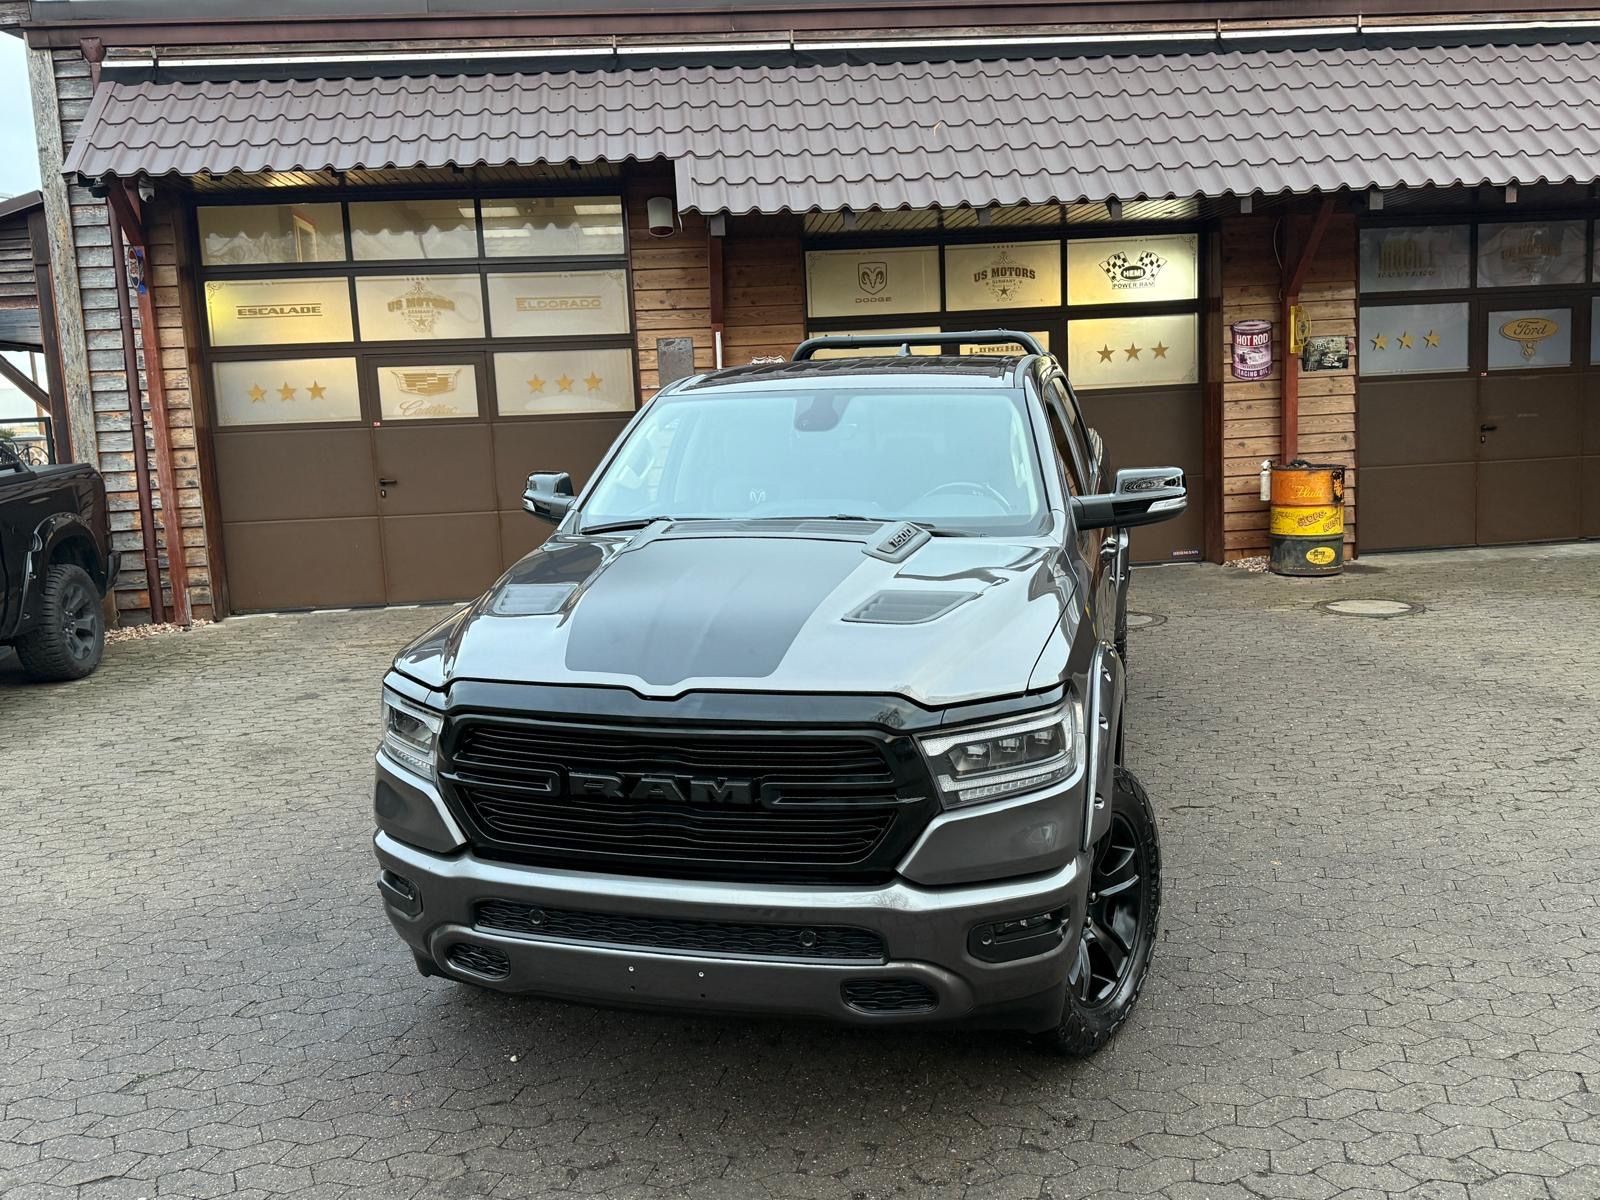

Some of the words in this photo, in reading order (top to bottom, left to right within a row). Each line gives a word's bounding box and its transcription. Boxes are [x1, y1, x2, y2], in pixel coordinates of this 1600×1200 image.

[973, 270, 988, 283] US
[990, 266, 1036, 280] MOTORS
[516, 298, 602, 312] ELDORADO
[855, 296, 893, 304] DODGE
[237, 306, 321, 316] ESCALADE
[1513, 320, 1548, 336] Ford
[1236, 334, 1252, 346] HOT
[1252, 333, 1269, 346] ROD
[969, 344, 1024, 354] LONGHO
[568, 770, 750, 804] RAM
